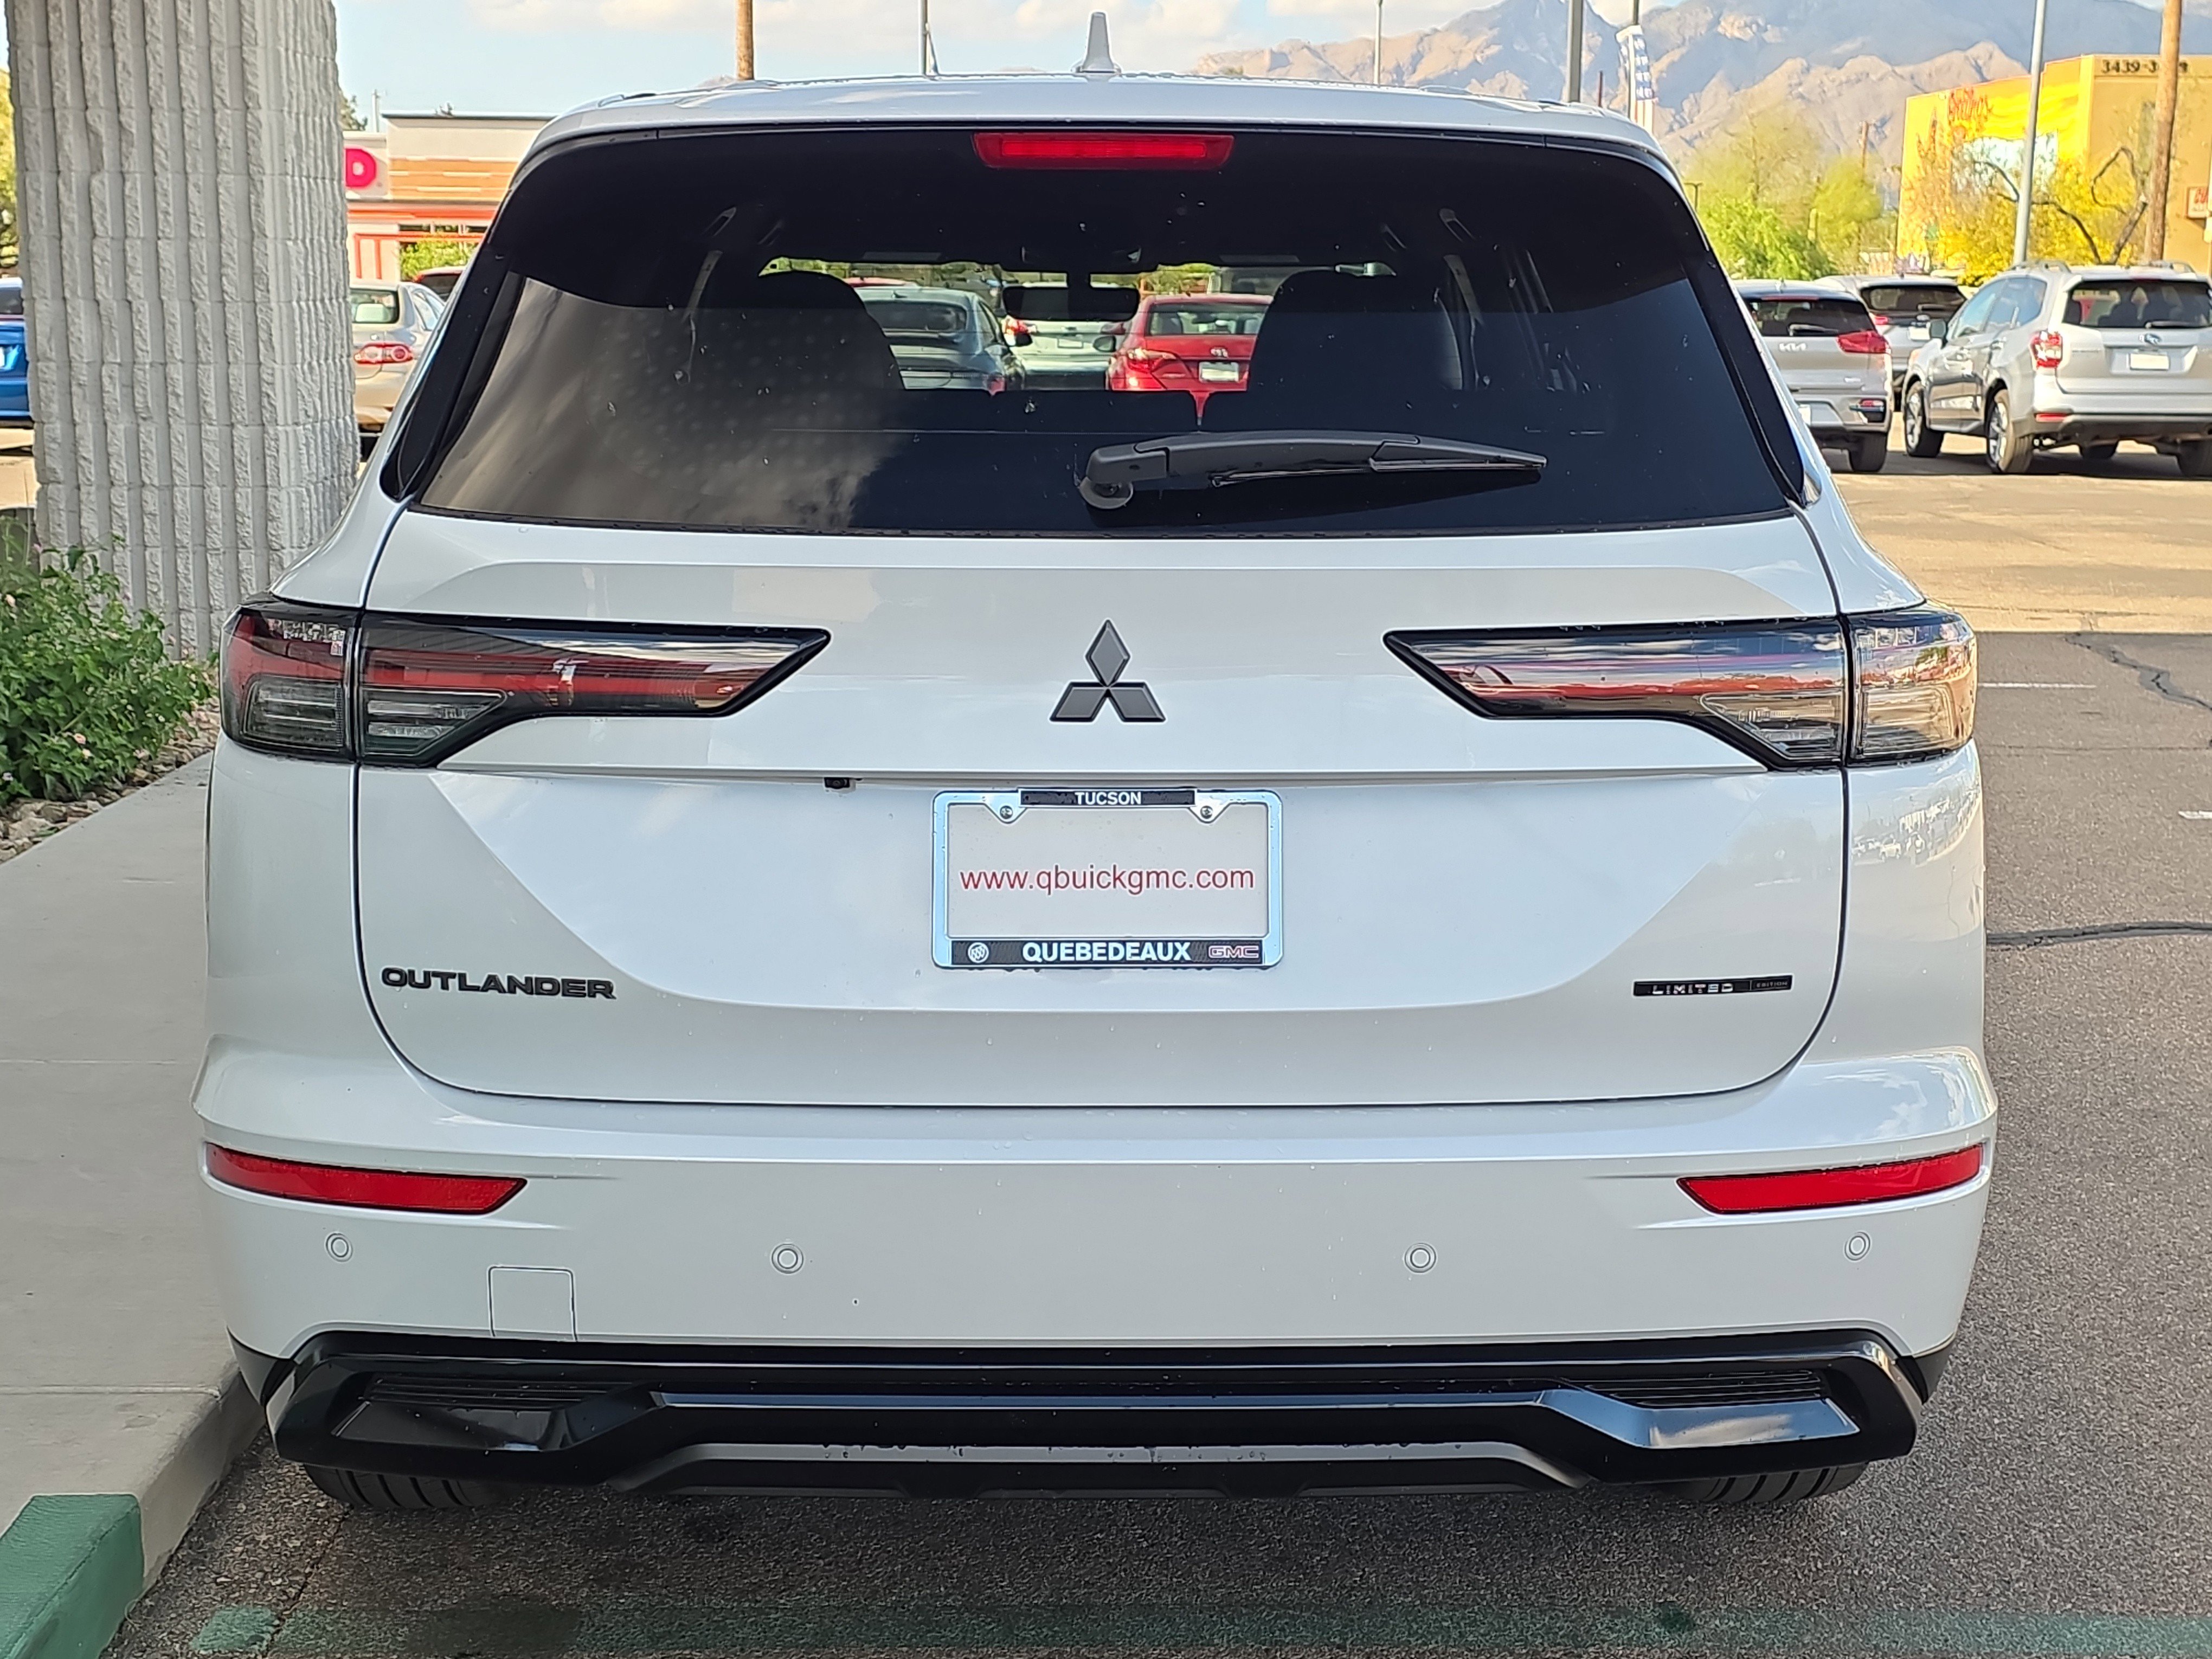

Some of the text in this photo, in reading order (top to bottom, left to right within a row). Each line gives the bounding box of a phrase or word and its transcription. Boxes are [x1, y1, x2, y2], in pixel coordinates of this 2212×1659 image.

[2101, 59, 2188, 73] 3439-39
[1075, 792, 1142, 805] TUCSON
[960, 864, 1255, 895] www.qbuickgmc.com
[1022, 942, 1259, 962] QUEBEDEAUX GMC
[382, 967, 617, 1000] OUTLANDER
[1652, 983, 1734, 994] LIMITED
